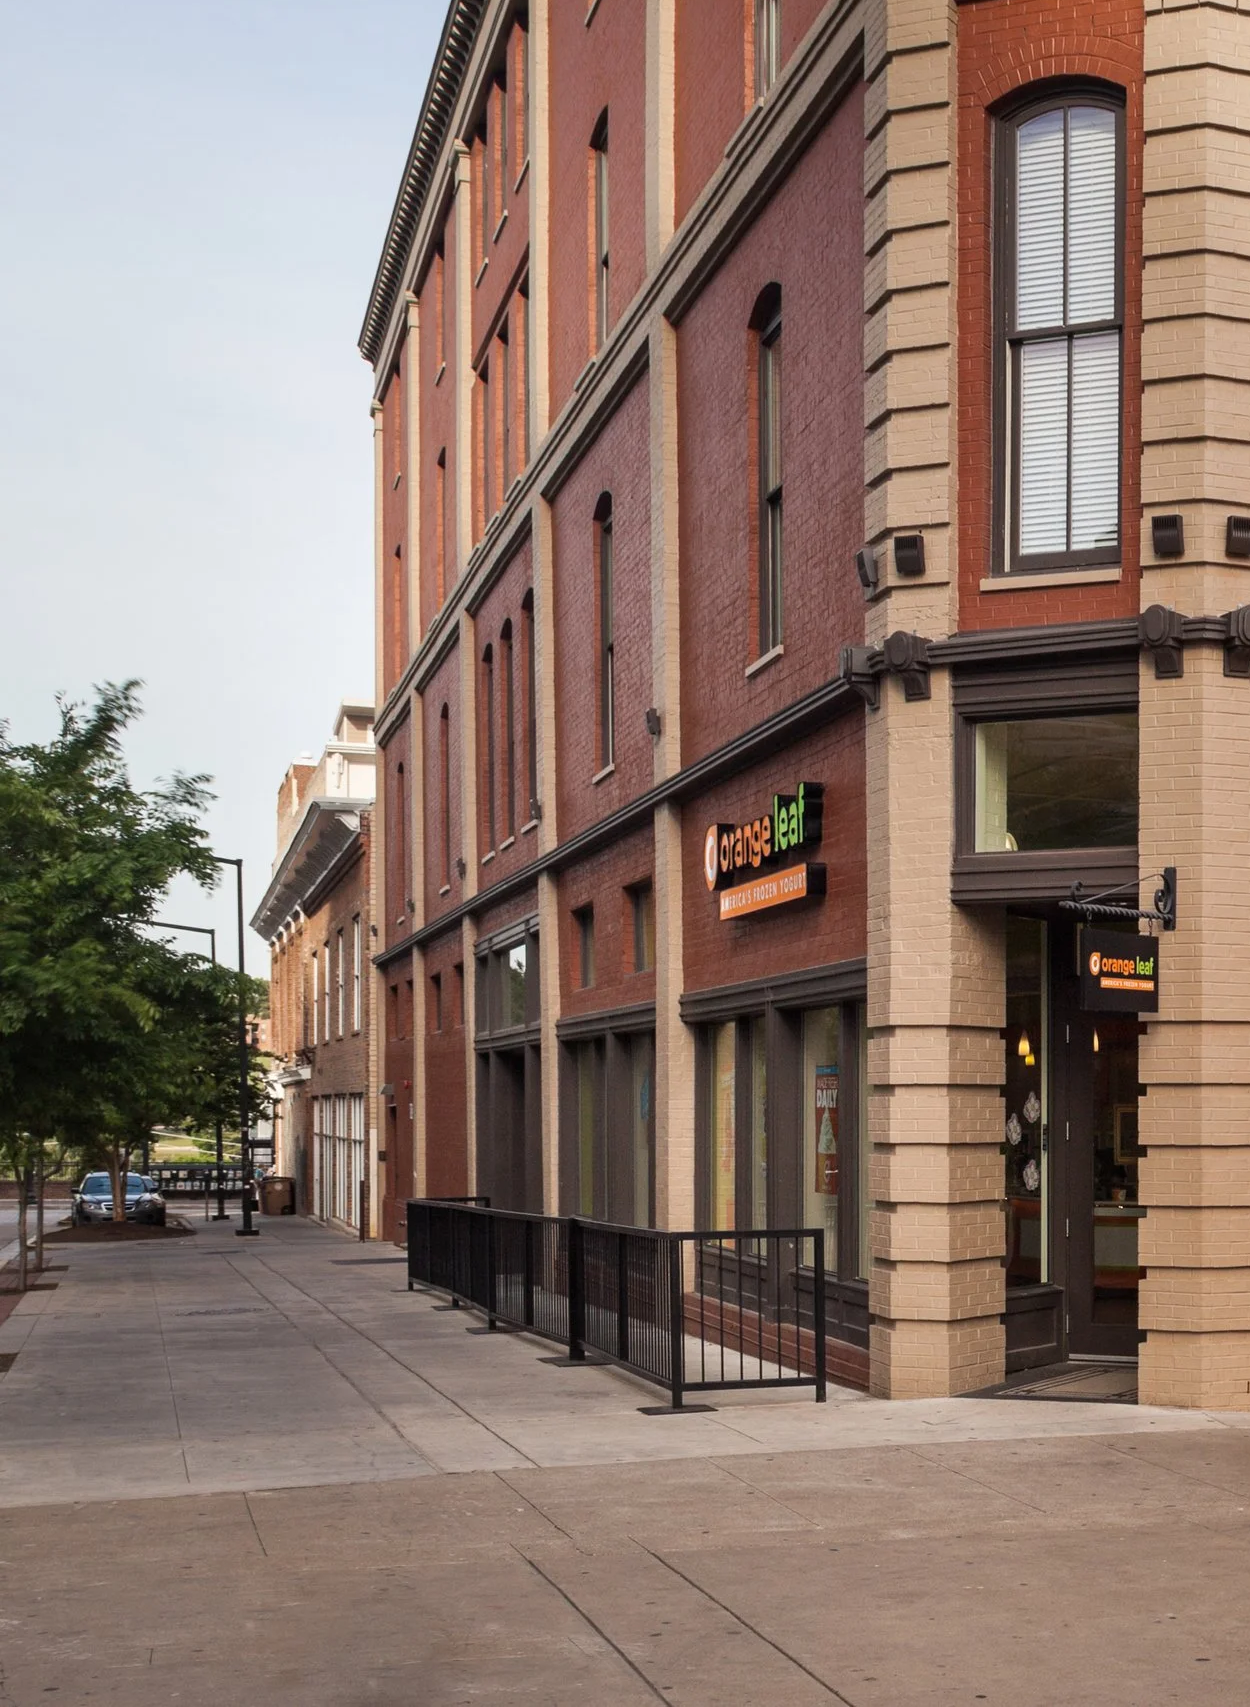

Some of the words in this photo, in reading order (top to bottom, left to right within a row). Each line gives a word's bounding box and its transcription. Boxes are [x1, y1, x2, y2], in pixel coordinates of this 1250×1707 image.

[720, 814, 771, 872] orange
[773, 782, 805, 852] leaf
[721, 889, 751, 912] AMERICA'S
[753, 881, 778, 903] FROZEN
[780, 871, 806, 894] YOGURT
[1101, 958, 1135, 976] orange
[1136, 956, 1154, 975] leaf
[816, 1089, 838, 1108] DAILY
